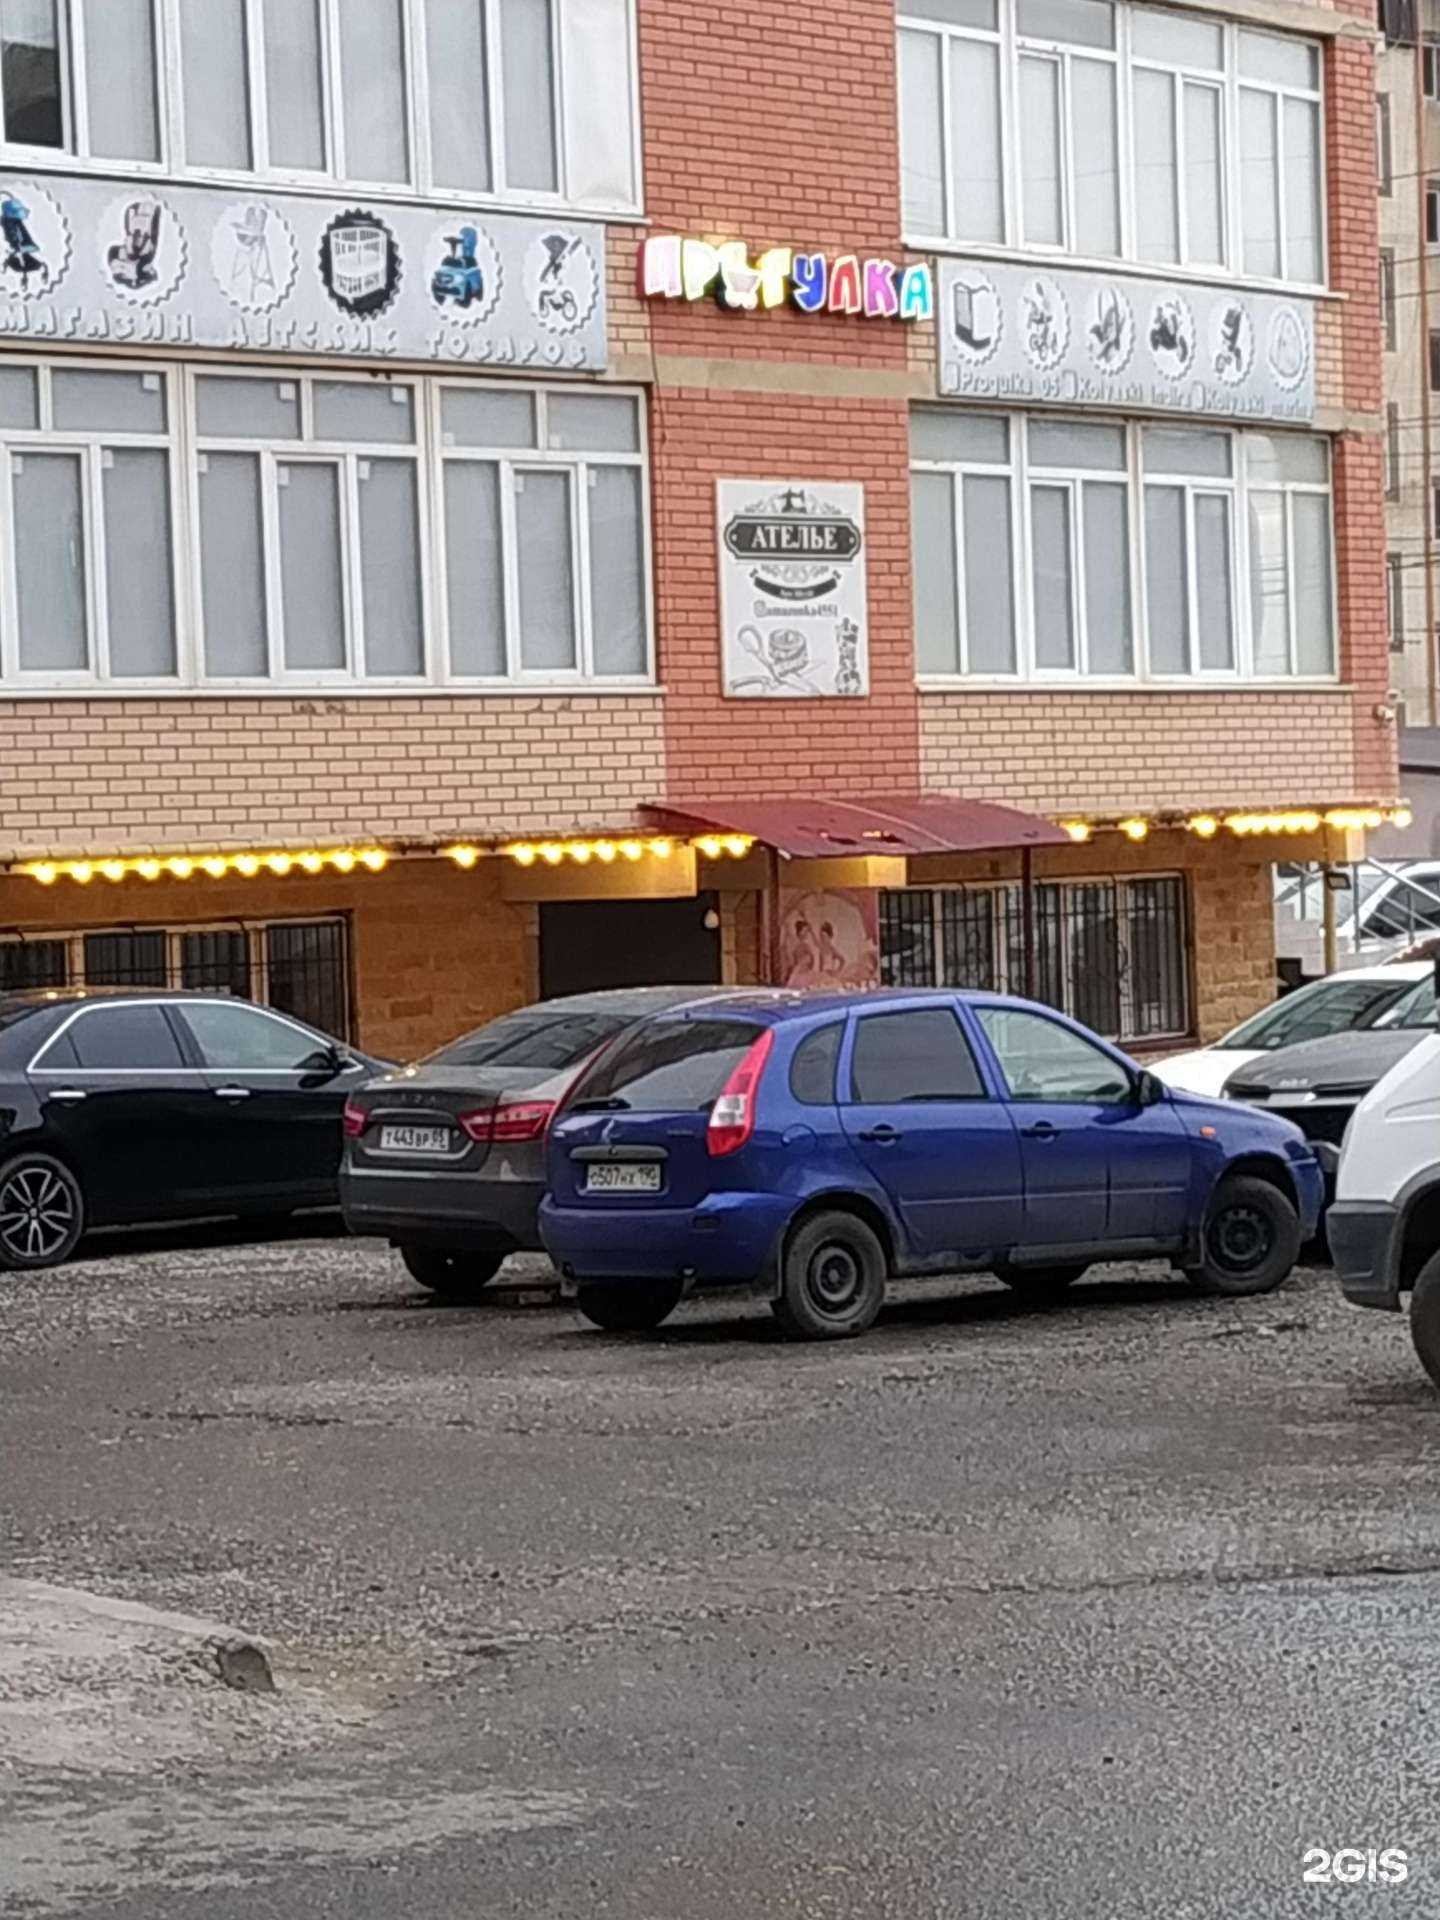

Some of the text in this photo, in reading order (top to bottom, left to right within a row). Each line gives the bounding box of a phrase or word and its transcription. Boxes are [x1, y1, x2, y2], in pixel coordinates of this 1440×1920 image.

[0, 303, 193, 342] МАГАЗИН
[424, 329, 588, 369] ТОВАРОВ
[751, 525, 838, 550] АТЕЛЬЕ
